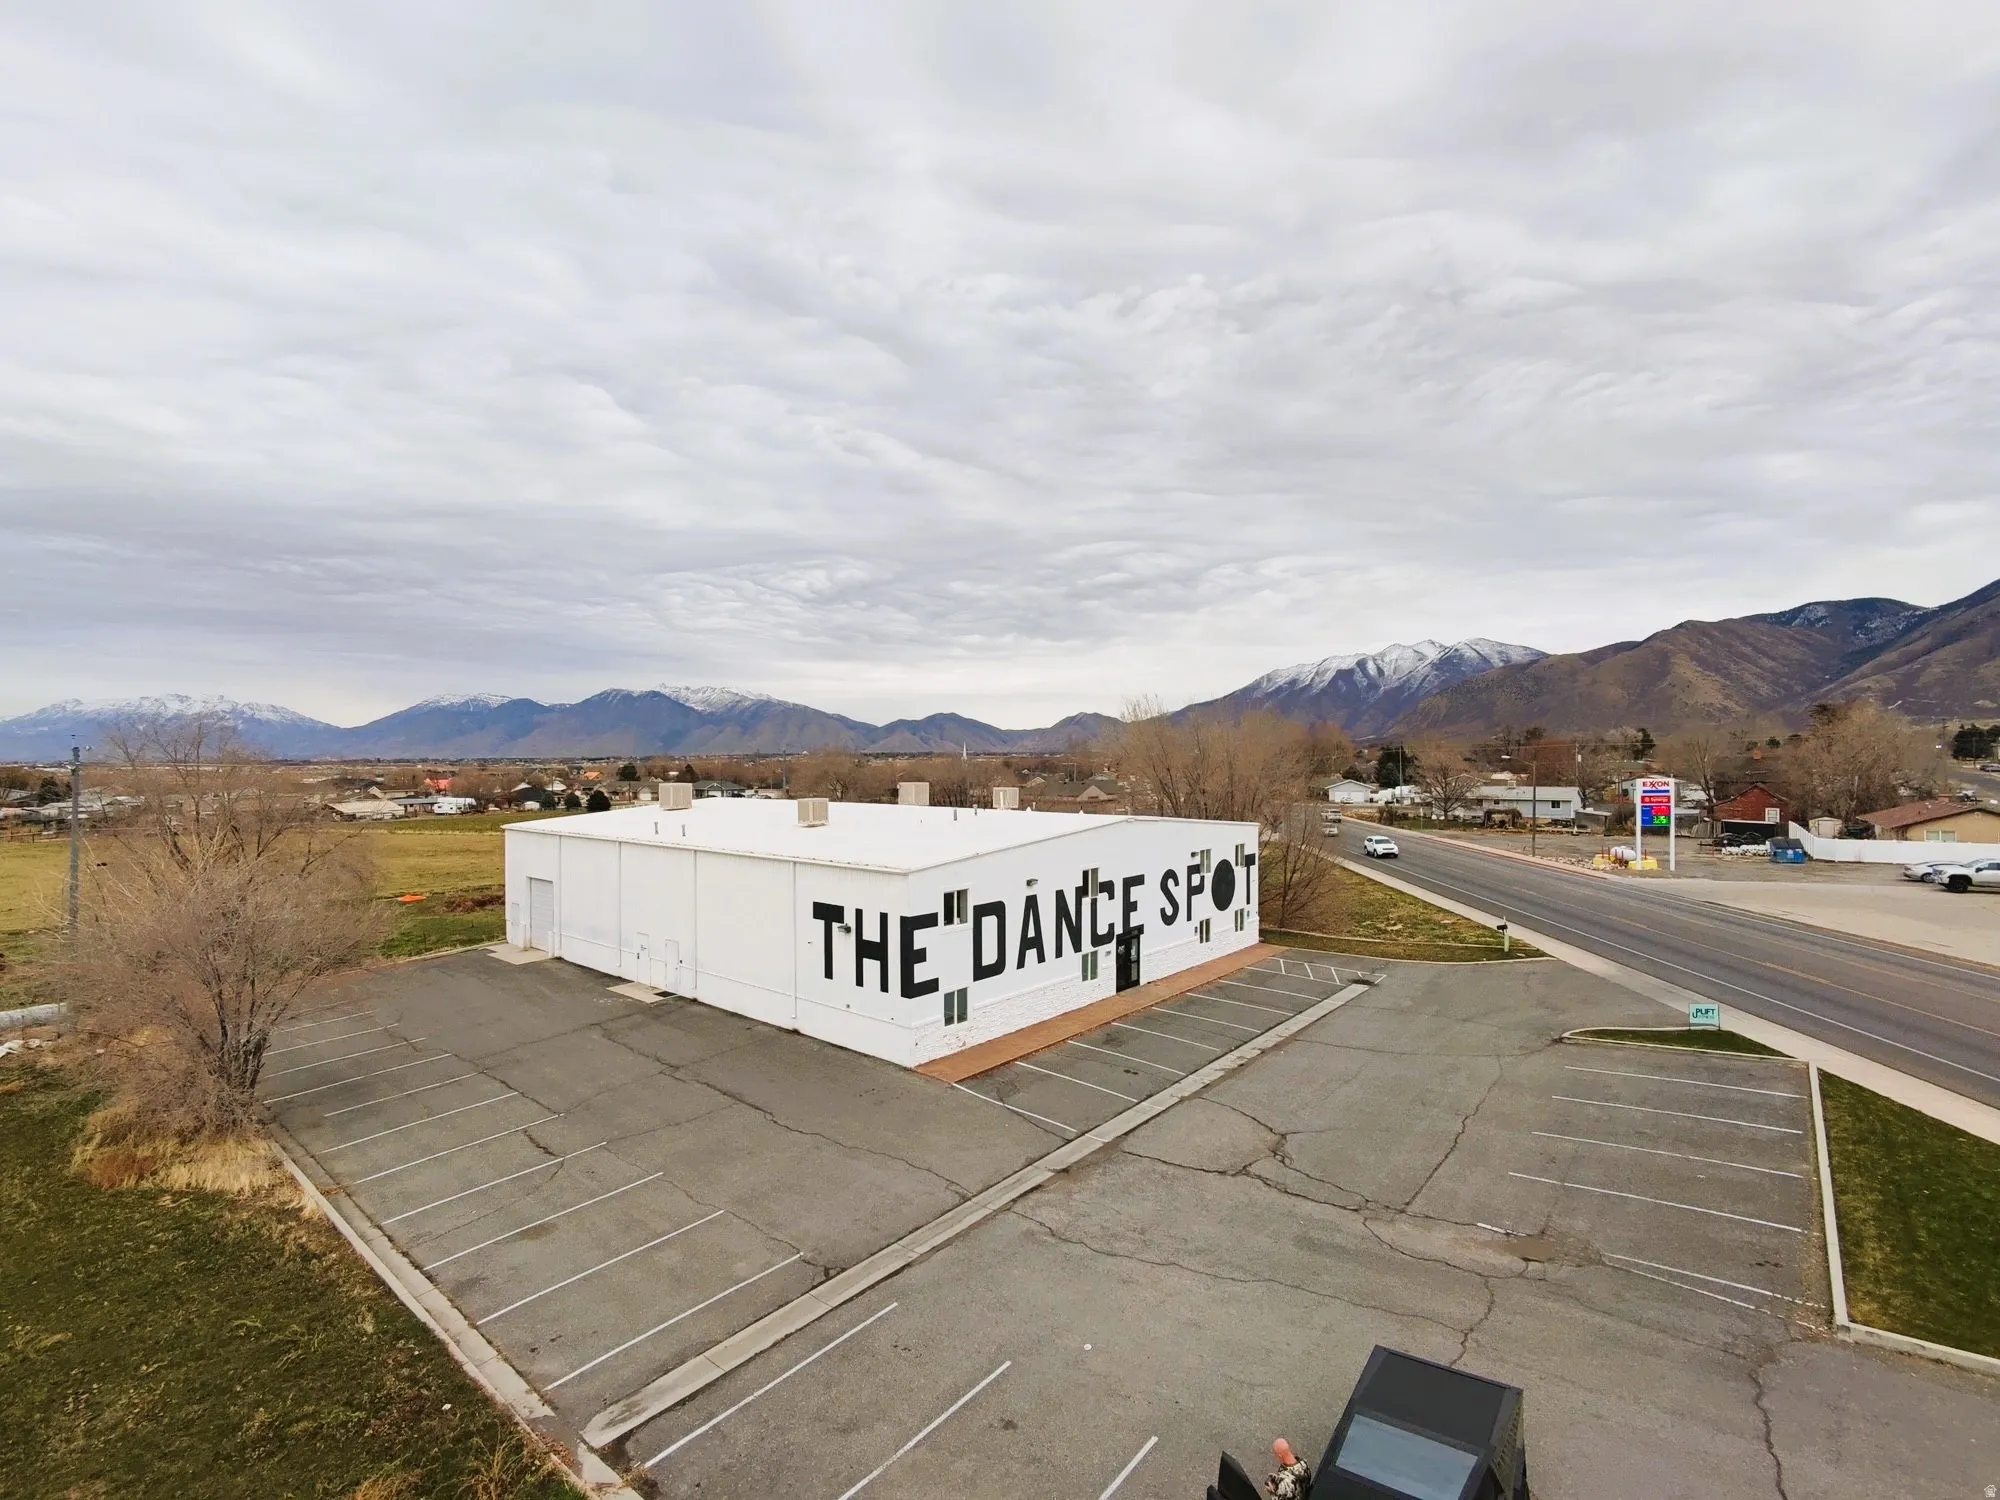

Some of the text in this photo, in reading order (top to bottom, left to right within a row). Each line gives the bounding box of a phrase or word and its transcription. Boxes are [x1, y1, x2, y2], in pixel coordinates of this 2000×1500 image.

[1642, 781, 1669, 789] EXXON
[812, 853, 1256, 999] THE DANCE SPOT
